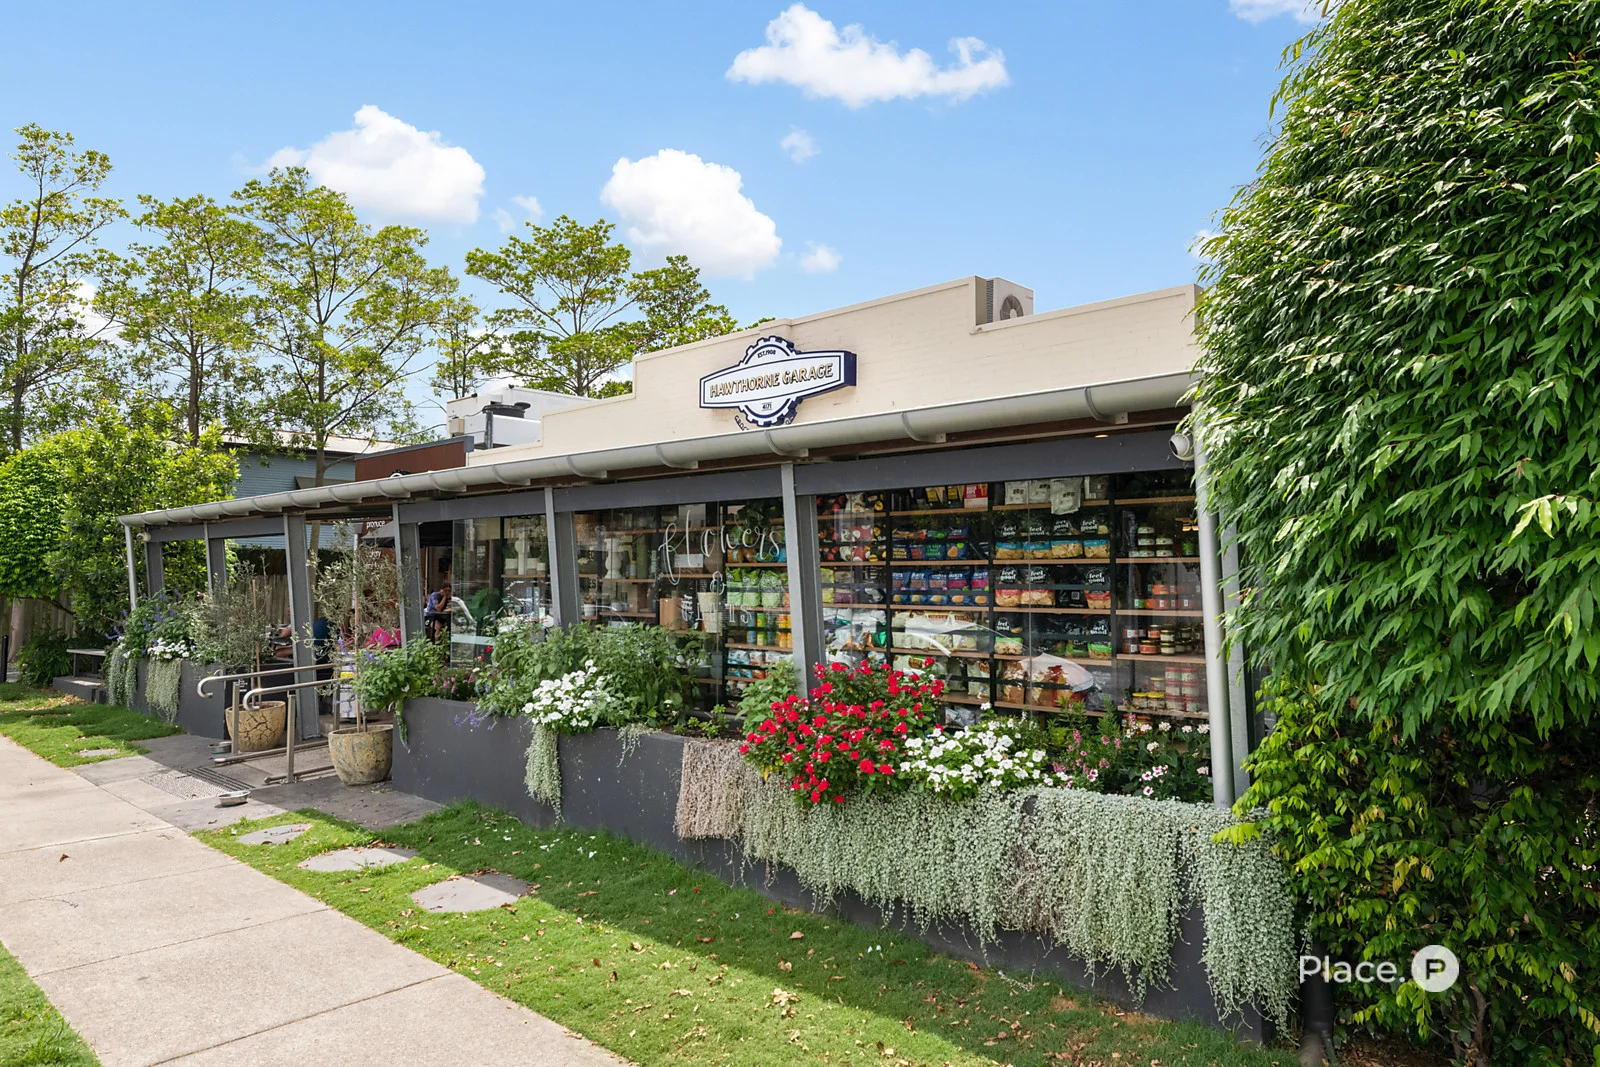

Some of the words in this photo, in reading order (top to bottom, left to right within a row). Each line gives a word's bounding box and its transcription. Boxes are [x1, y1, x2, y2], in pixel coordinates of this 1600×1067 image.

[710, 372, 781, 398] HAWTHORNE
[782, 363, 834, 385] GARAGE
[658, 510, 780, 586] flowers
